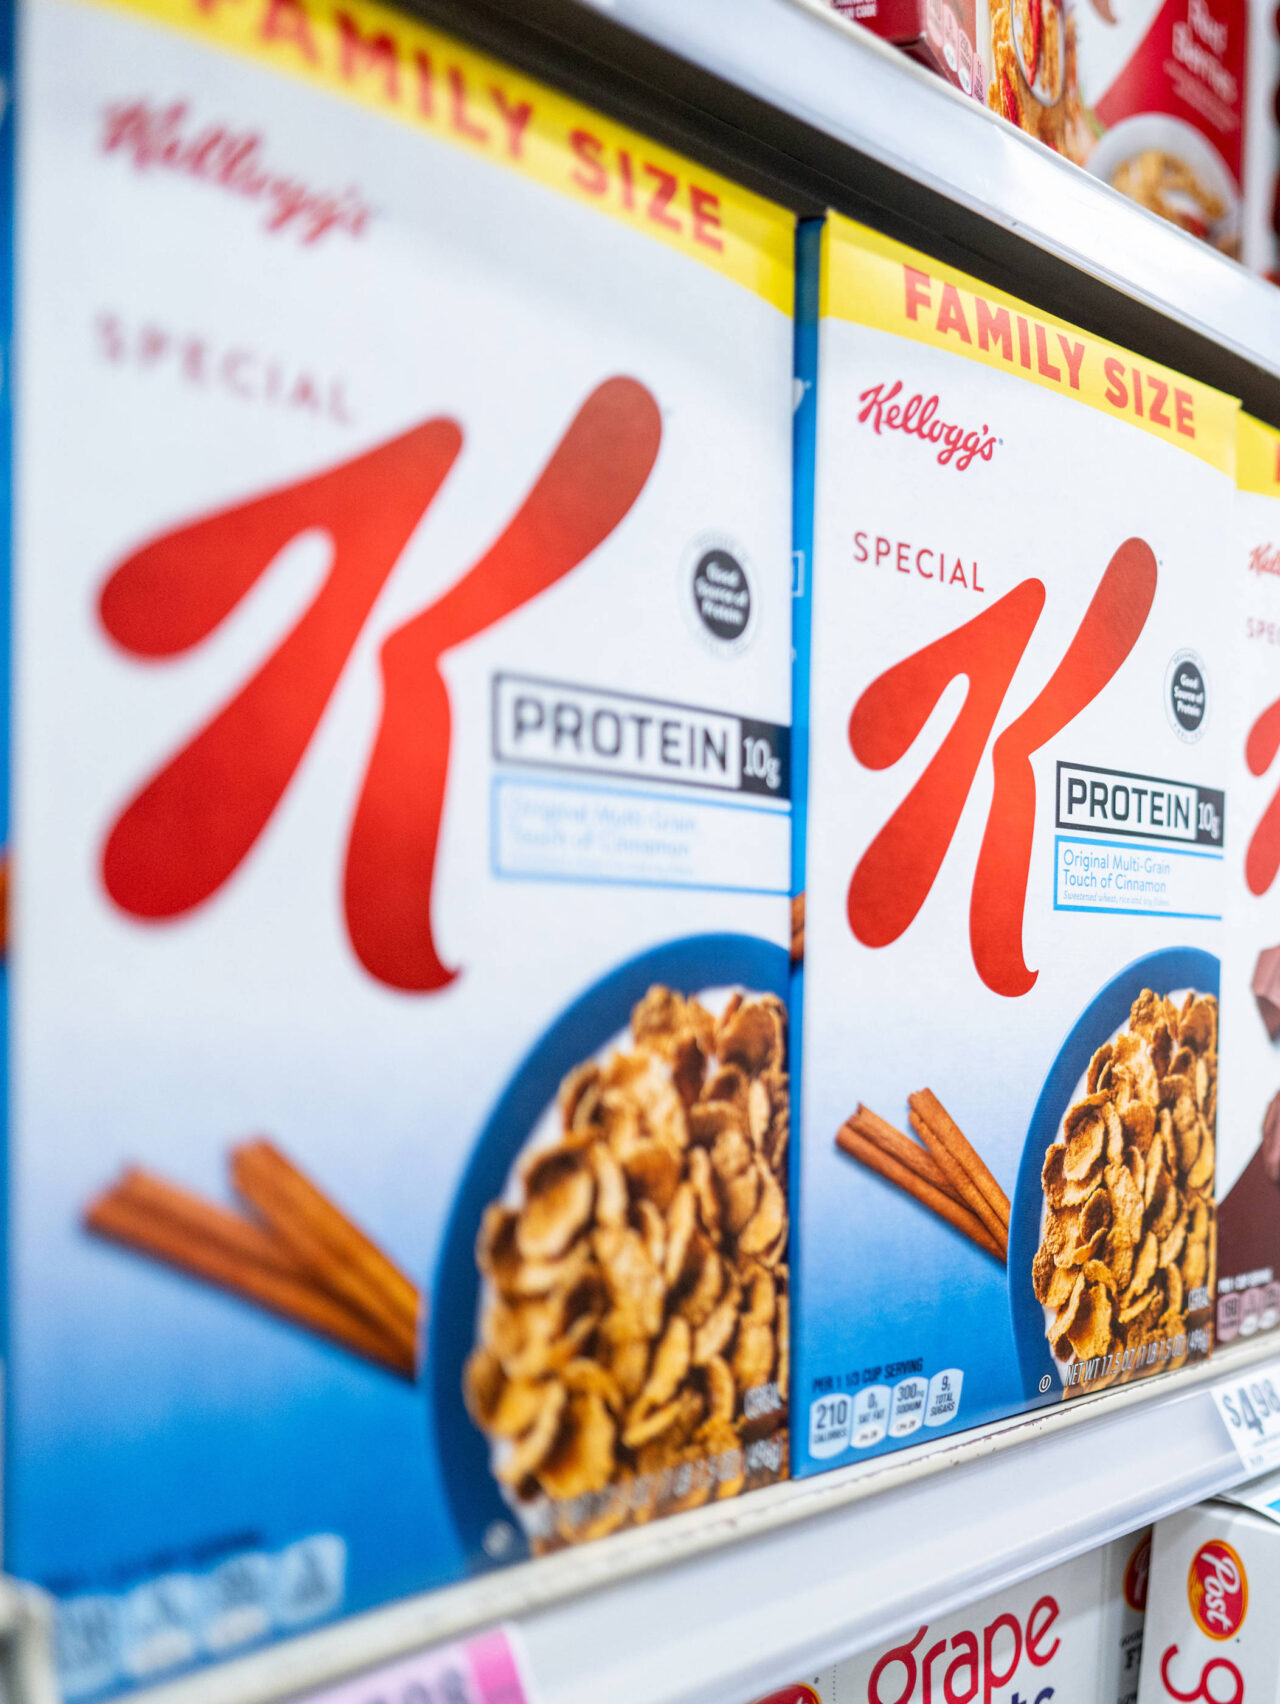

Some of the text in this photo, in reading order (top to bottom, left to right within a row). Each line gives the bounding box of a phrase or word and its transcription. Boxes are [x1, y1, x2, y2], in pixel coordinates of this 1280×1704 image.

[193, 0, 725, 253] AMILY SIZE
[94, 309, 352, 425] SPECIAL
[903, 264, 1197, 439] FAMILY SIZE
[857, 380, 997, 472] Kellogg's
[853, 531, 986, 593] SPECIAL
[513, 696, 781, 790] PROTEIN 10g
[1067, 777, 1221, 840] PROTEIN 10g
[1063, 849, 1171, 875] Original Multi-Grain
[1063, 869, 1167, 893] Touch of Cinnamon
[884, 1357, 924, 1380] SERVING
[1065, 1361, 1084, 1387] NET
[1084, 1356, 1101, 1382] WT
[1121, 1348, 1135, 1371] OZ
[816, 1399, 849, 1430] 210
[1201, 1552, 1240, 1632] Post
[867, 1595, 1061, 1704] grape
